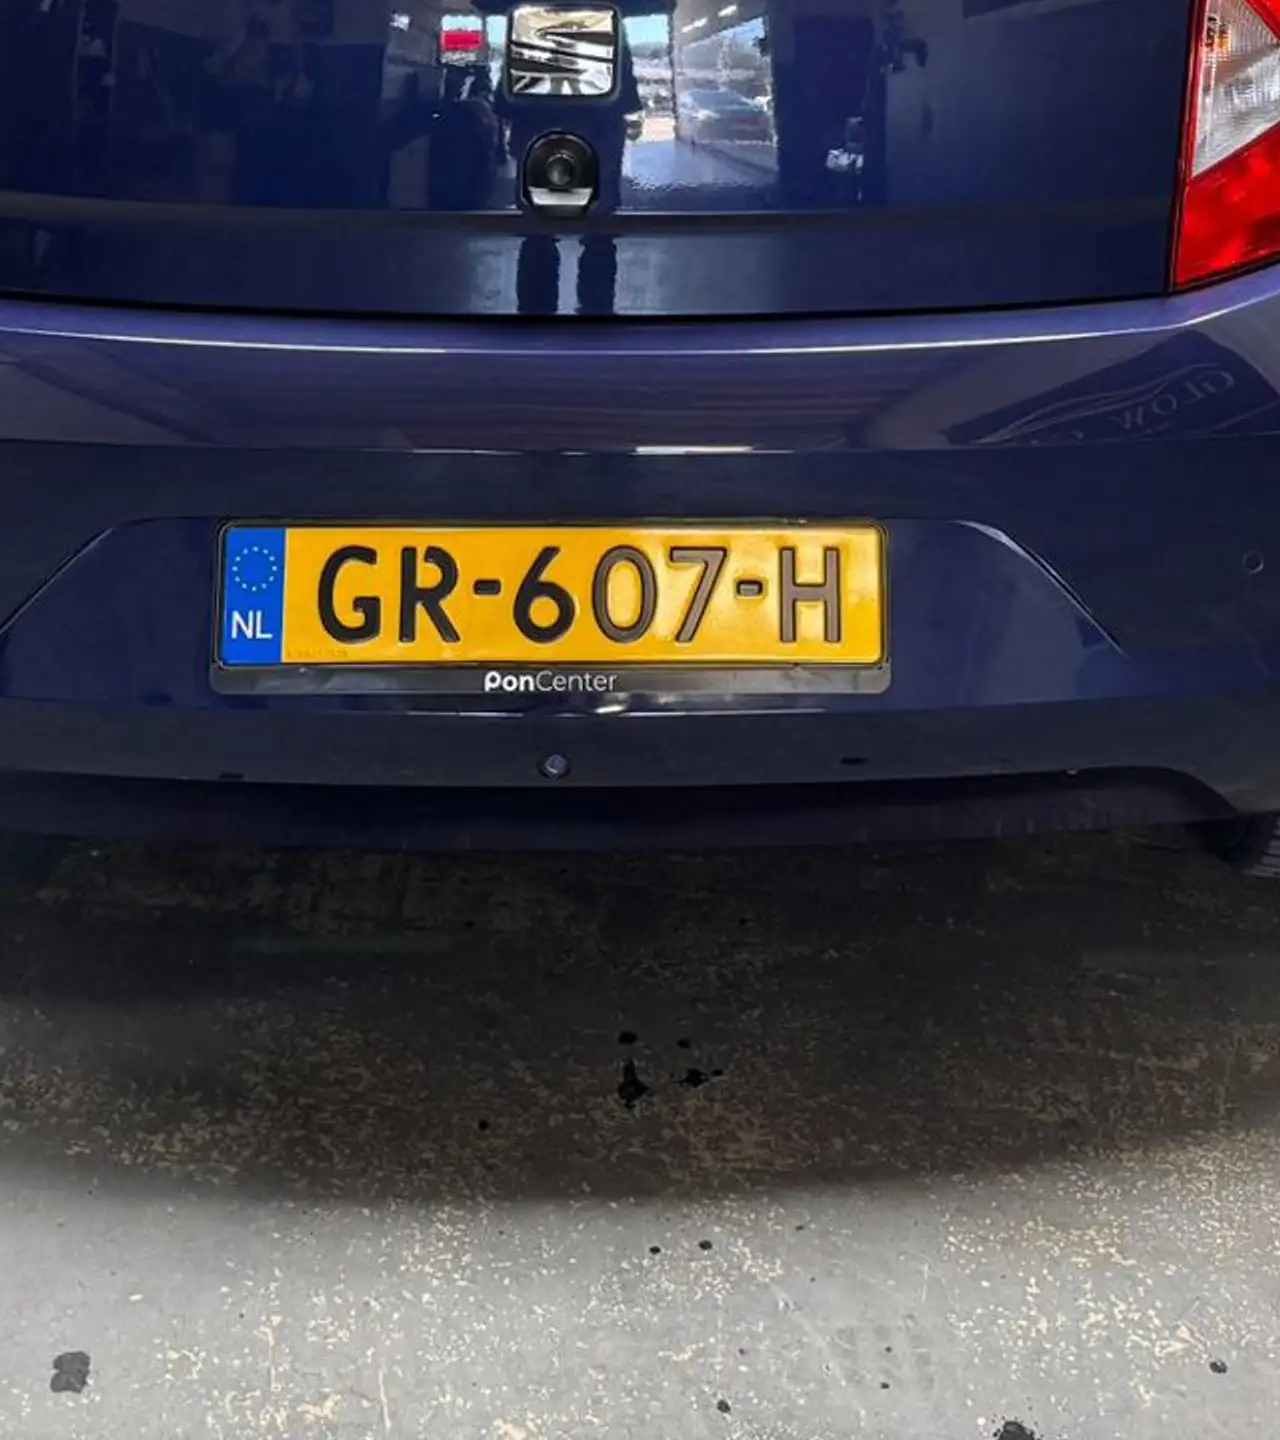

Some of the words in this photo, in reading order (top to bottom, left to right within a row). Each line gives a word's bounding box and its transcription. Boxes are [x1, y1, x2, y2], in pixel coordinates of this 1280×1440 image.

[231, 610, 273, 639] NL
[318, 545, 841, 645] GR-607-H
[483, 670, 617, 692] PonCenter
